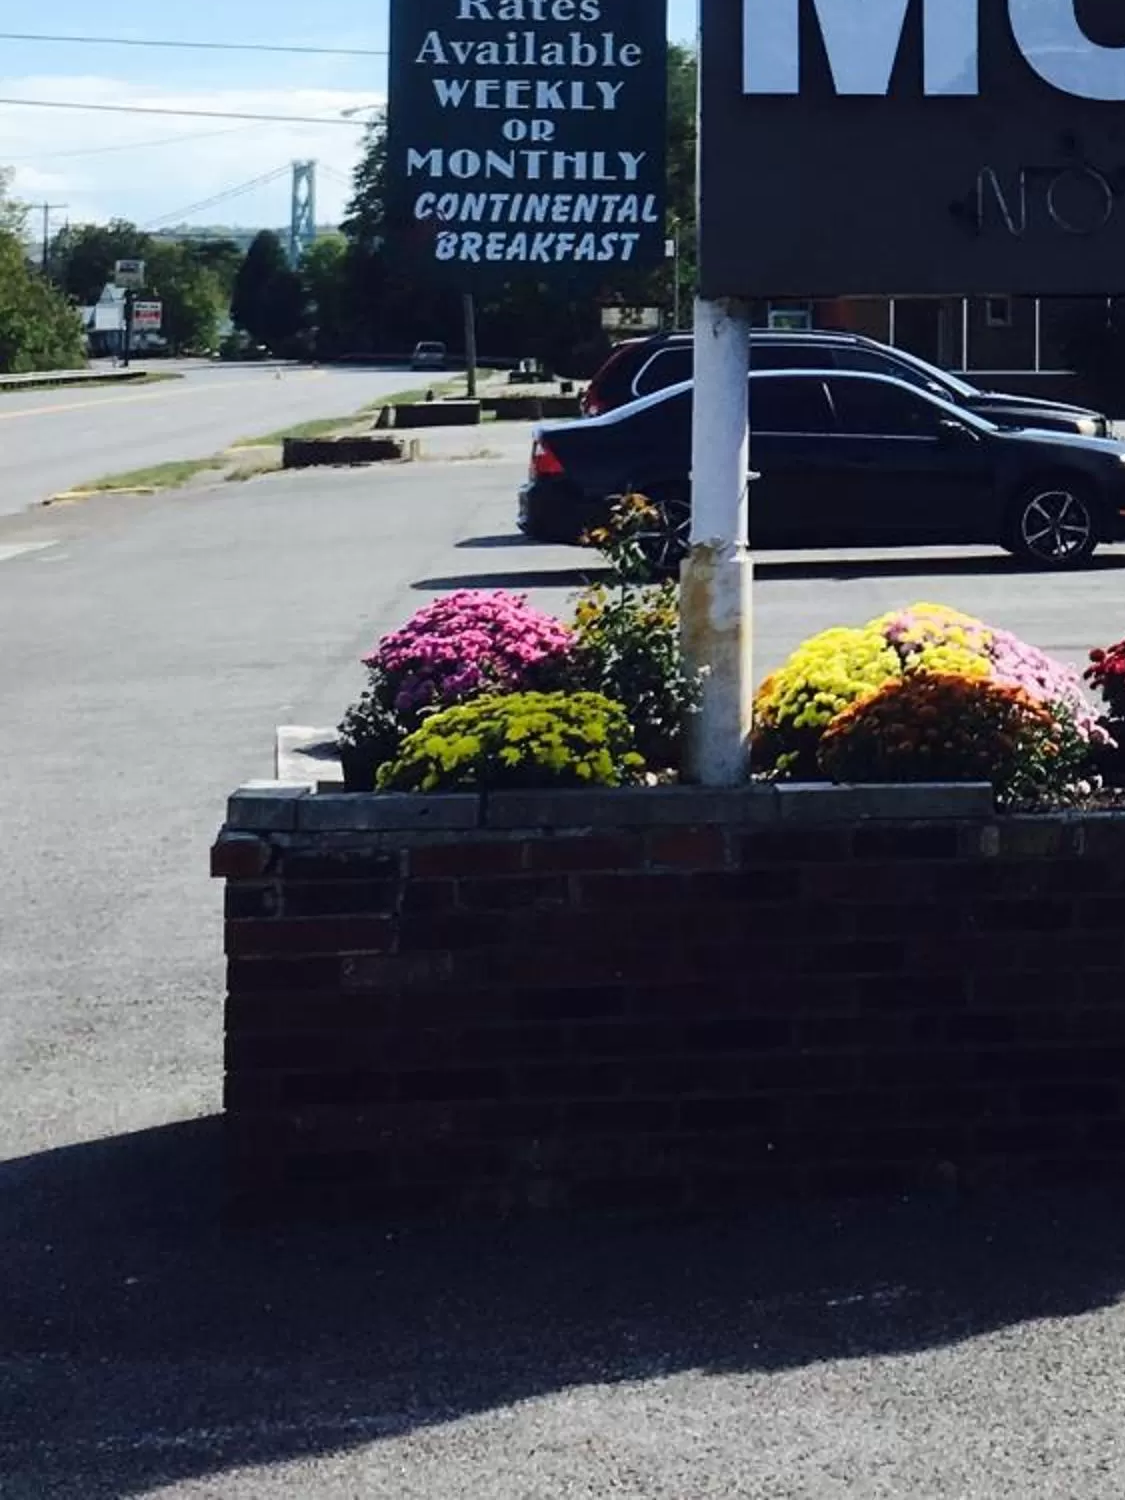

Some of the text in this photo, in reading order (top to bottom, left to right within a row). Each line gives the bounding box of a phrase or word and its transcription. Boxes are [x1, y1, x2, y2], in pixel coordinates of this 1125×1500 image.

[416, 31, 641, 66] Available
[433, 80, 624, 109] WEEKLY
[503, 119, 554, 141] OR
[408, 148, 645, 180] MONTHLY
[415, 192, 657, 222] CONTINENTAL
[976, 164, 1113, 237] NO
[436, 231, 640, 262] BREAKFAST
